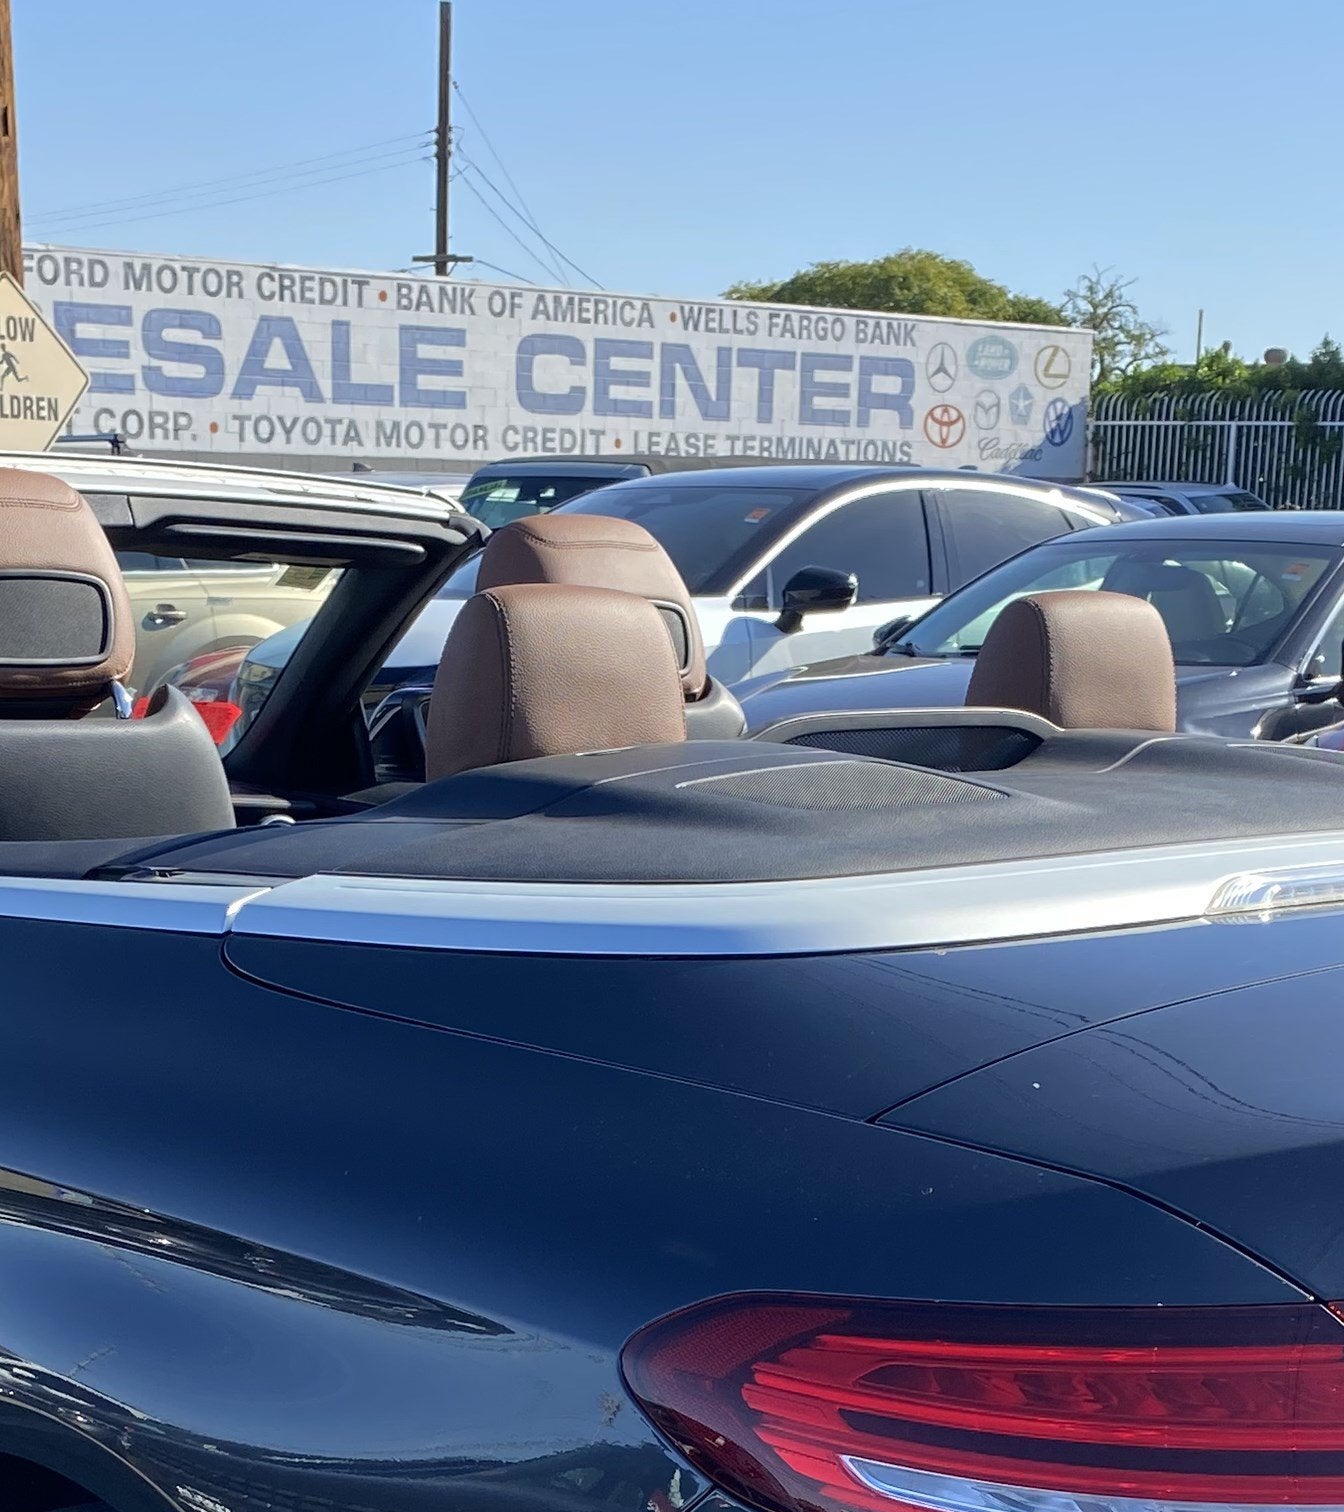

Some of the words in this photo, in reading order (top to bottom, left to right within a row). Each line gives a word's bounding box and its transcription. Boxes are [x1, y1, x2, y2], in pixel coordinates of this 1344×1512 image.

[123, 260, 245, 299] MOTOR
[256, 271, 370, 308] CREDIT
[396, 283, 476, 316] BANK
[488, 290, 524, 319] OF
[531, 295, 655, 329] AMERICA
[679, 307, 758, 336] WELLS
[767, 313, 847, 342] FARGO
[855, 317, 917, 347] BANK
[32, 300, 468, 411] ESALE
[515, 333, 915, 430] CENTER
[94, 409, 197, 441] CORP.
[232, 414, 357, 447] TOYOTA
[375, 421, 489, 451] MOTOR
[502, 425, 604, 453] CREDIT
[634, 430, 716, 458] LEASE
[725, 435, 912, 464] TERMINATIONS
[978, 437, 1043, 464] Cadillac
